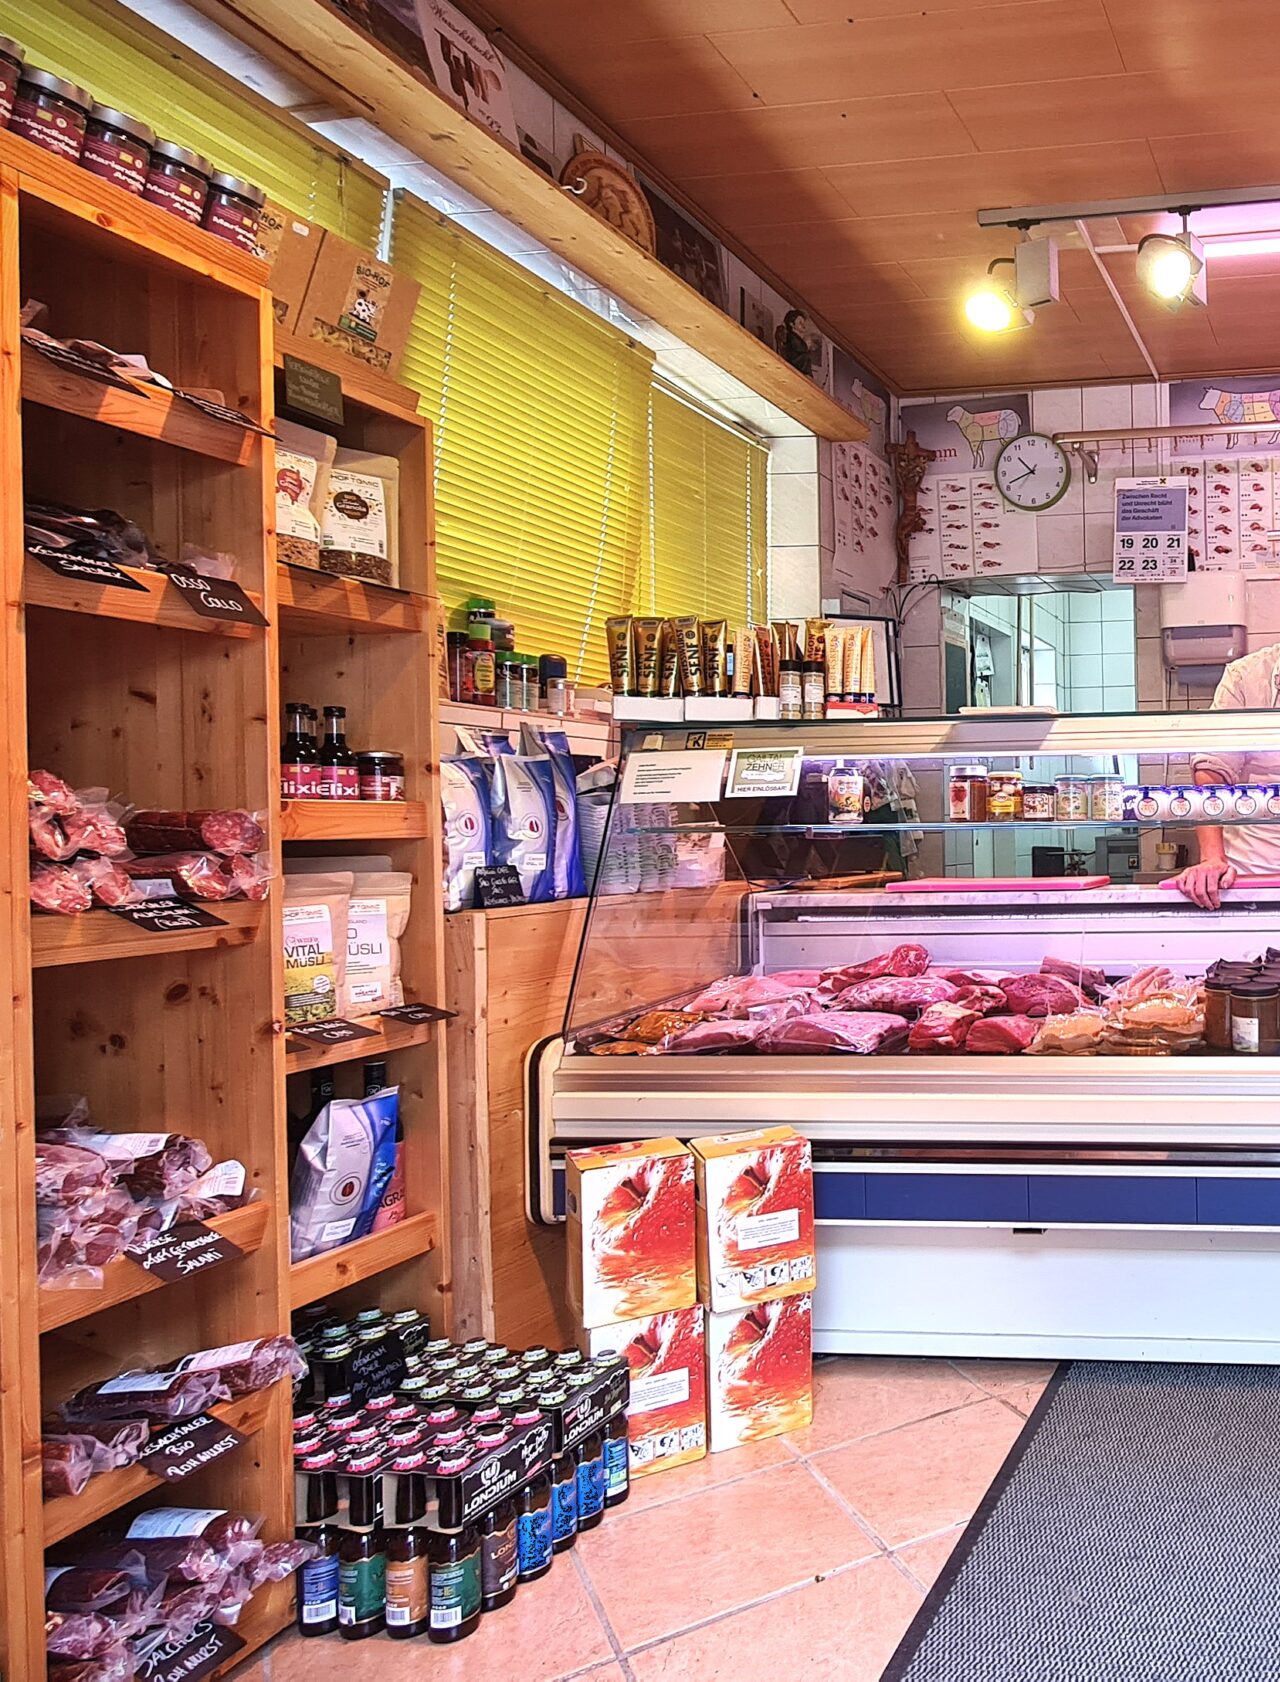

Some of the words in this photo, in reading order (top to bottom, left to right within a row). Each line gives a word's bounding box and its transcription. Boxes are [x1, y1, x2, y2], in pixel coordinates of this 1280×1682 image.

[355, 264, 391, 289] BIO-HOF
[1120, 538, 1134, 548] 19
[1142, 538, 1158, 548] 20
[1167, 538, 1180, 548] 21
[1118, 560, 1135, 570] 22
[1142, 560, 1158, 570] 23
[170, 573, 211, 591] OSSO
[616, 643, 629, 678] SENF
[644, 644, 657, 679] SENF
[664, 647, 677, 680] SENF
[686, 642, 701, 676] SENF
[708, 647, 720, 679] SENF
[746, 762, 785, 771] ZEHNER
[284, 942, 325, 958] VITAL
[348, 942, 383, 955] ÜSLI
[286, 955, 326, 970] MÜSLI
[196, 1434, 239, 1462] WURST
[183, 1633, 224, 1670] WURST
